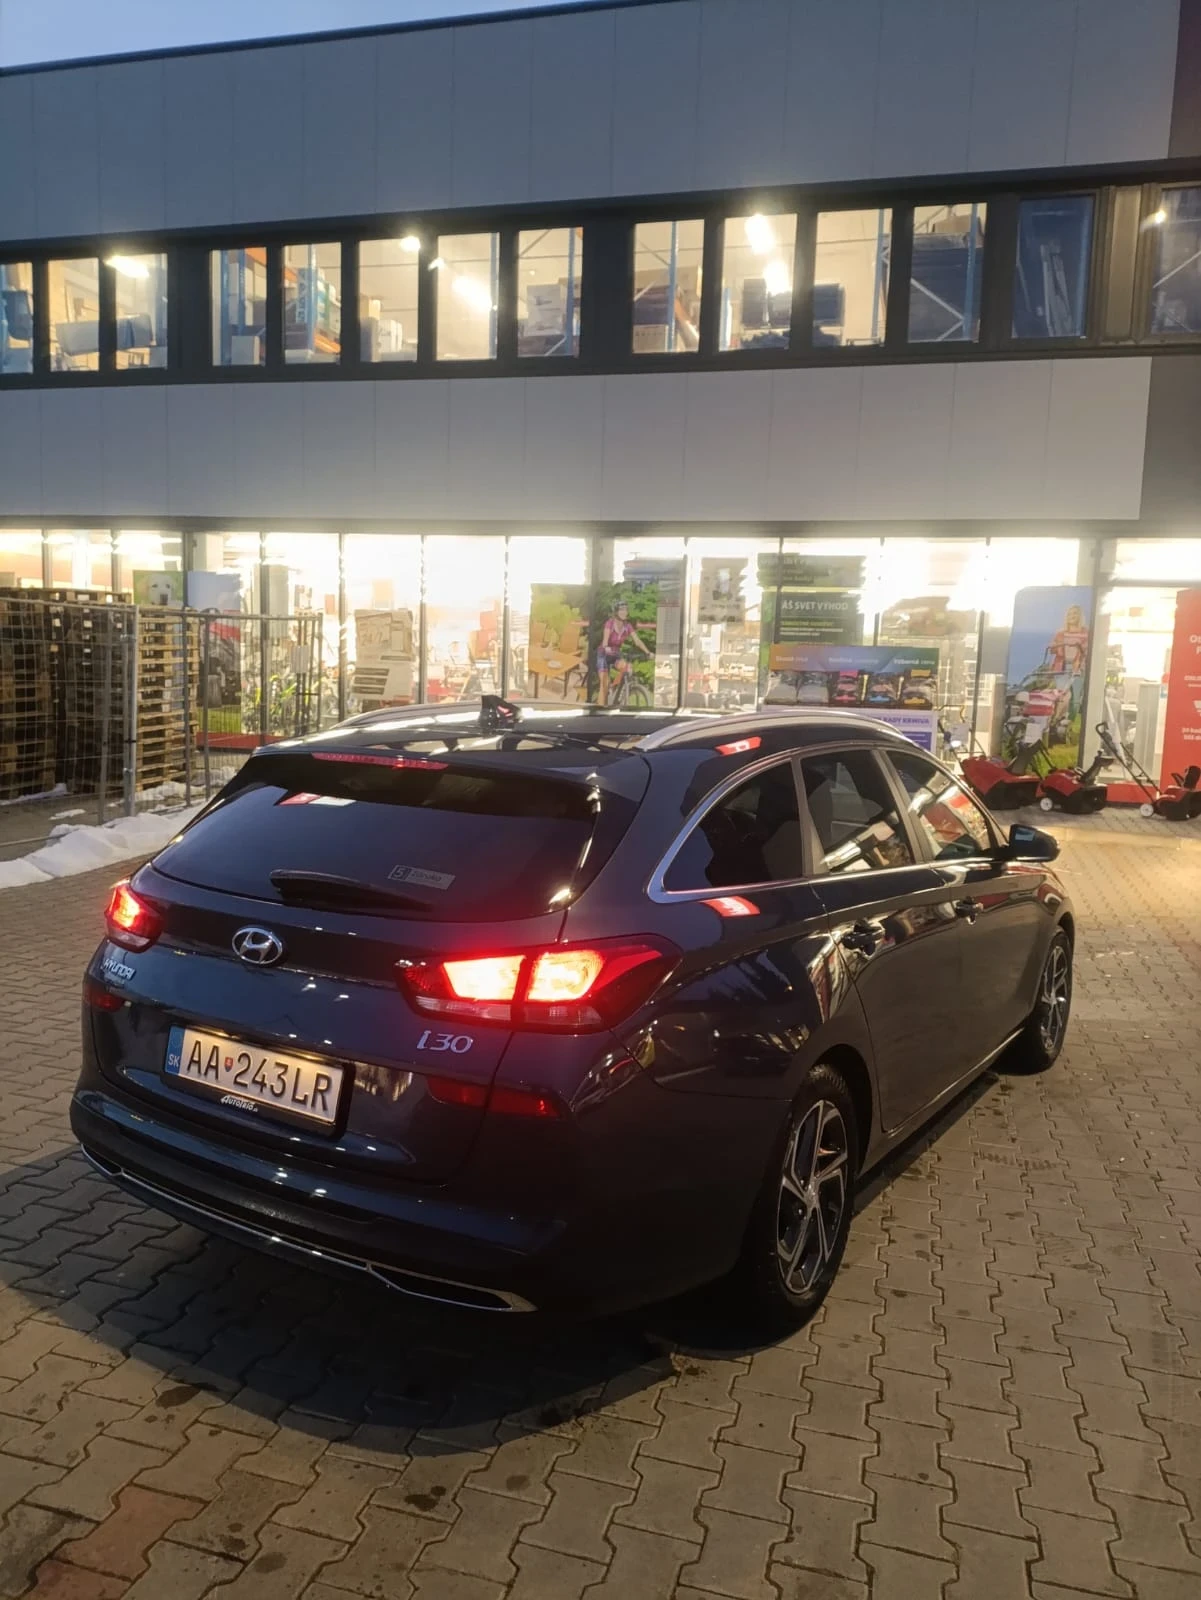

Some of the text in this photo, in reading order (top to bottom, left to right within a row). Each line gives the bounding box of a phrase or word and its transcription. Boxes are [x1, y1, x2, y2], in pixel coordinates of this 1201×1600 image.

[794, 601, 816, 610] SVET
[167, 1053, 180, 1068] SK
[186, 1039, 333, 1112] AA 243LR
